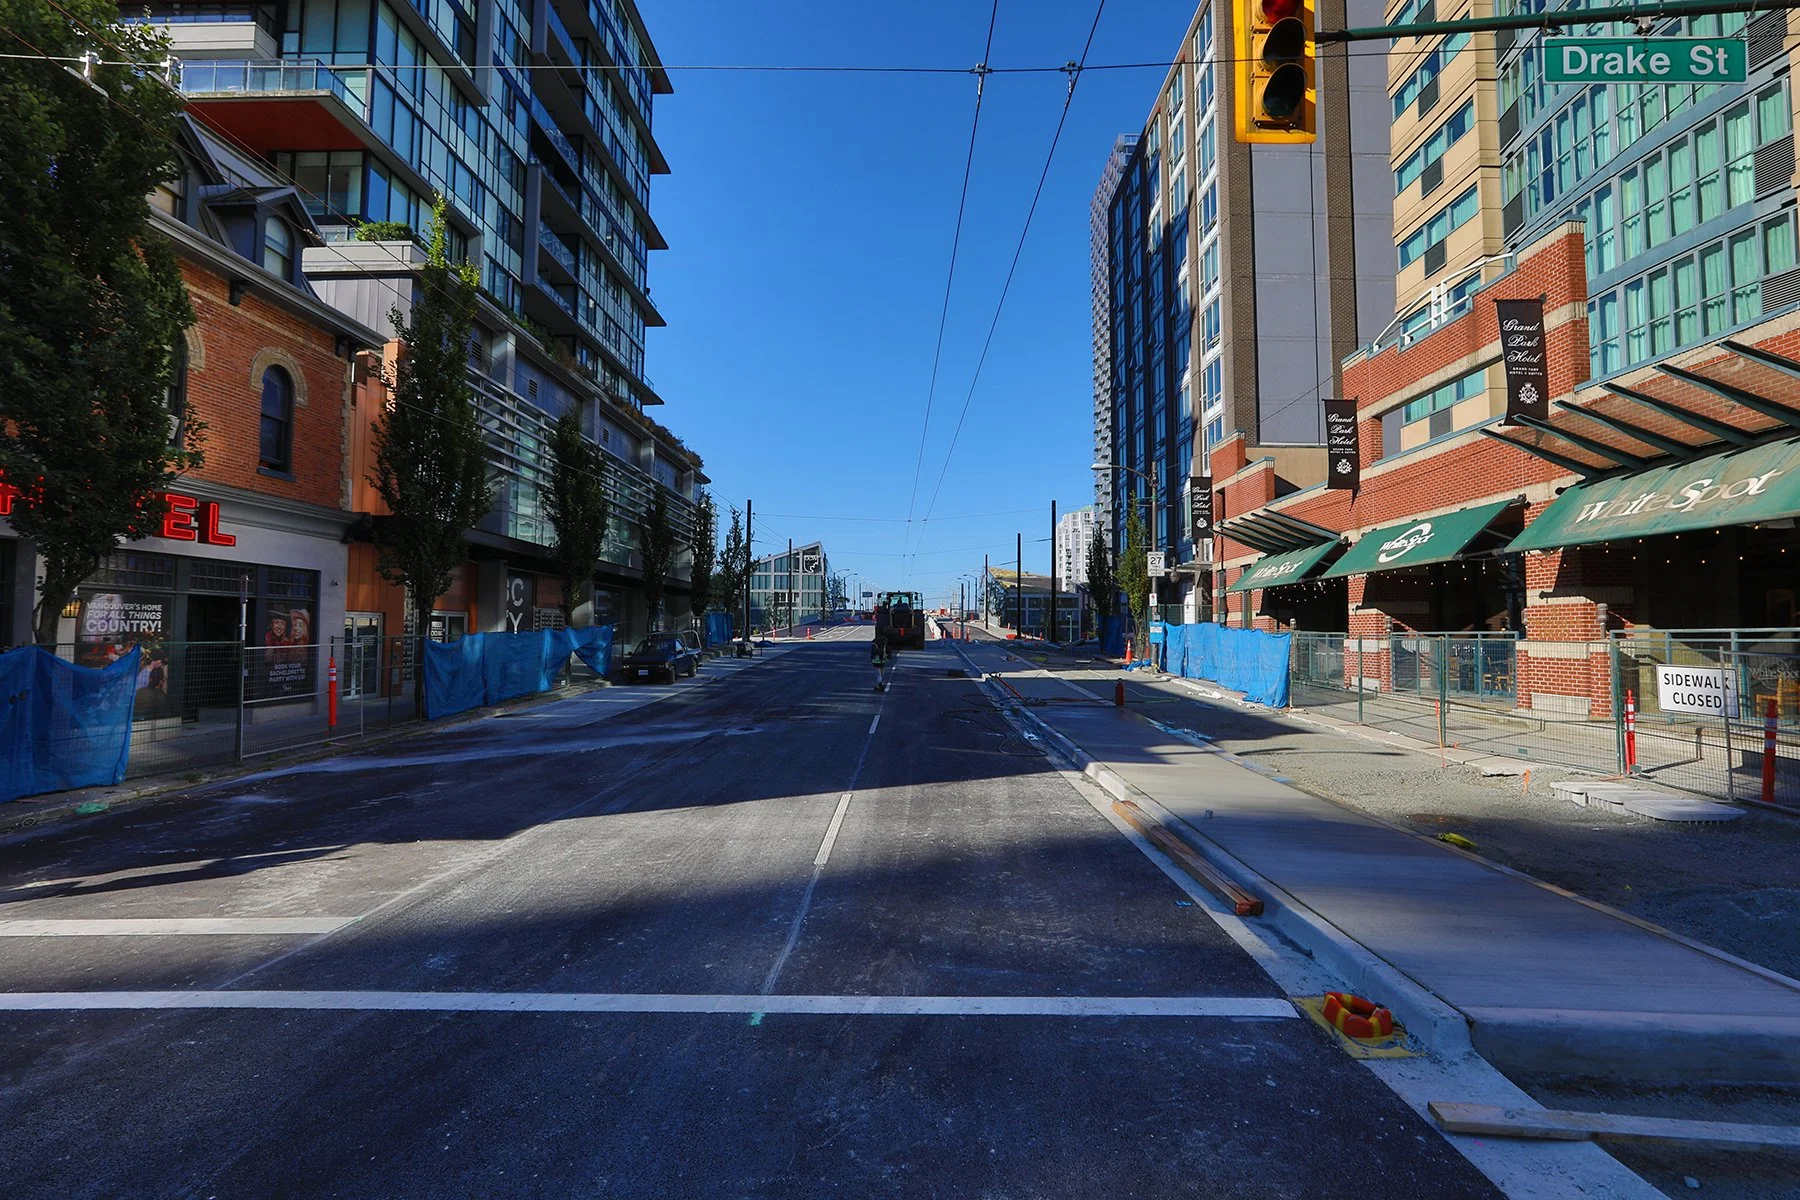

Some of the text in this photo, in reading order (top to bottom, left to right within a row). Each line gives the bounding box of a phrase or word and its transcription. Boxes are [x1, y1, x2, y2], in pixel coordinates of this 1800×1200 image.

[1563, 45, 1729, 75] Drake St
[1502, 319, 1540, 331] Grand
[1507, 334, 1539, 347] Park
[1507, 350, 1543, 363] Hotel
[1150, 556, 1162, 565] 27
[87, 602, 140, 611] VANCOUVER'S
[87, 610, 162, 620] FOR ALL THINGS
[86, 620, 162, 632] COUNTRY!
[1672, 692, 1722, 709] CLOSED
